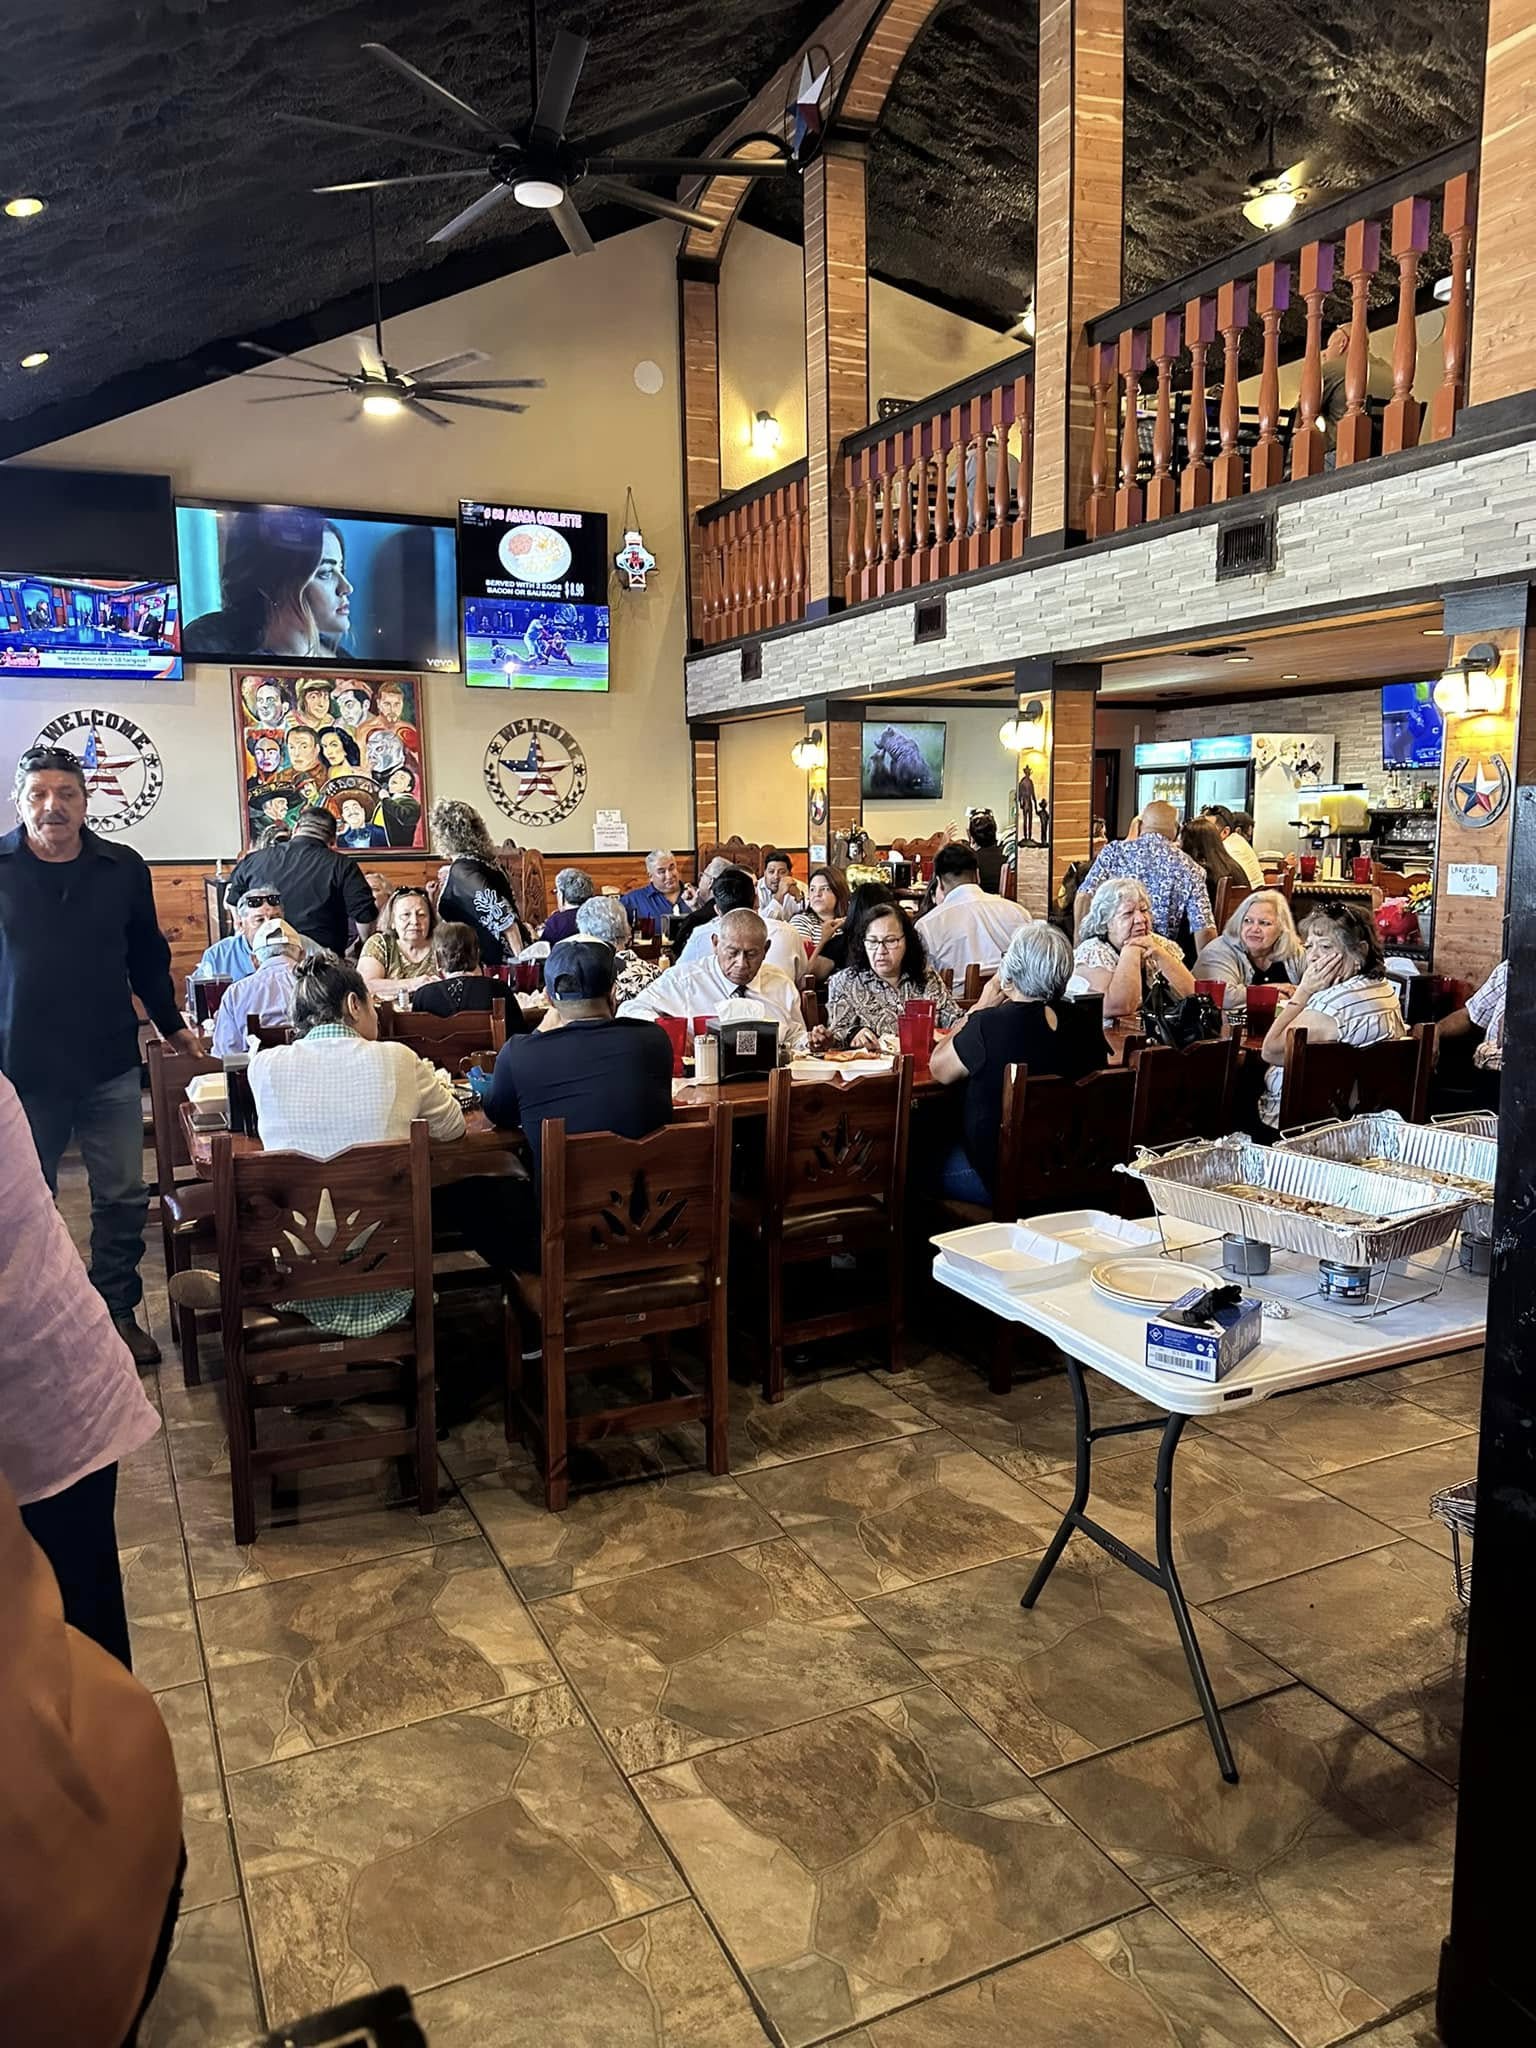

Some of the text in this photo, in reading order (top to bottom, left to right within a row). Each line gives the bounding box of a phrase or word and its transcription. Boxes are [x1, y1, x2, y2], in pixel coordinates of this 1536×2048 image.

[505, 508, 536, 524] ASADA
[537, 510, 582, 528] OMELETTE
[485, 579, 515, 587] SERVED
[516, 581, 535, 589] WITH
[542, 583, 562, 591] EGGS
[527, 589, 561, 598] SAUSAGE
[41, 709, 151, 750] WELCOME
[500, 718, 583, 760] WELCOME
